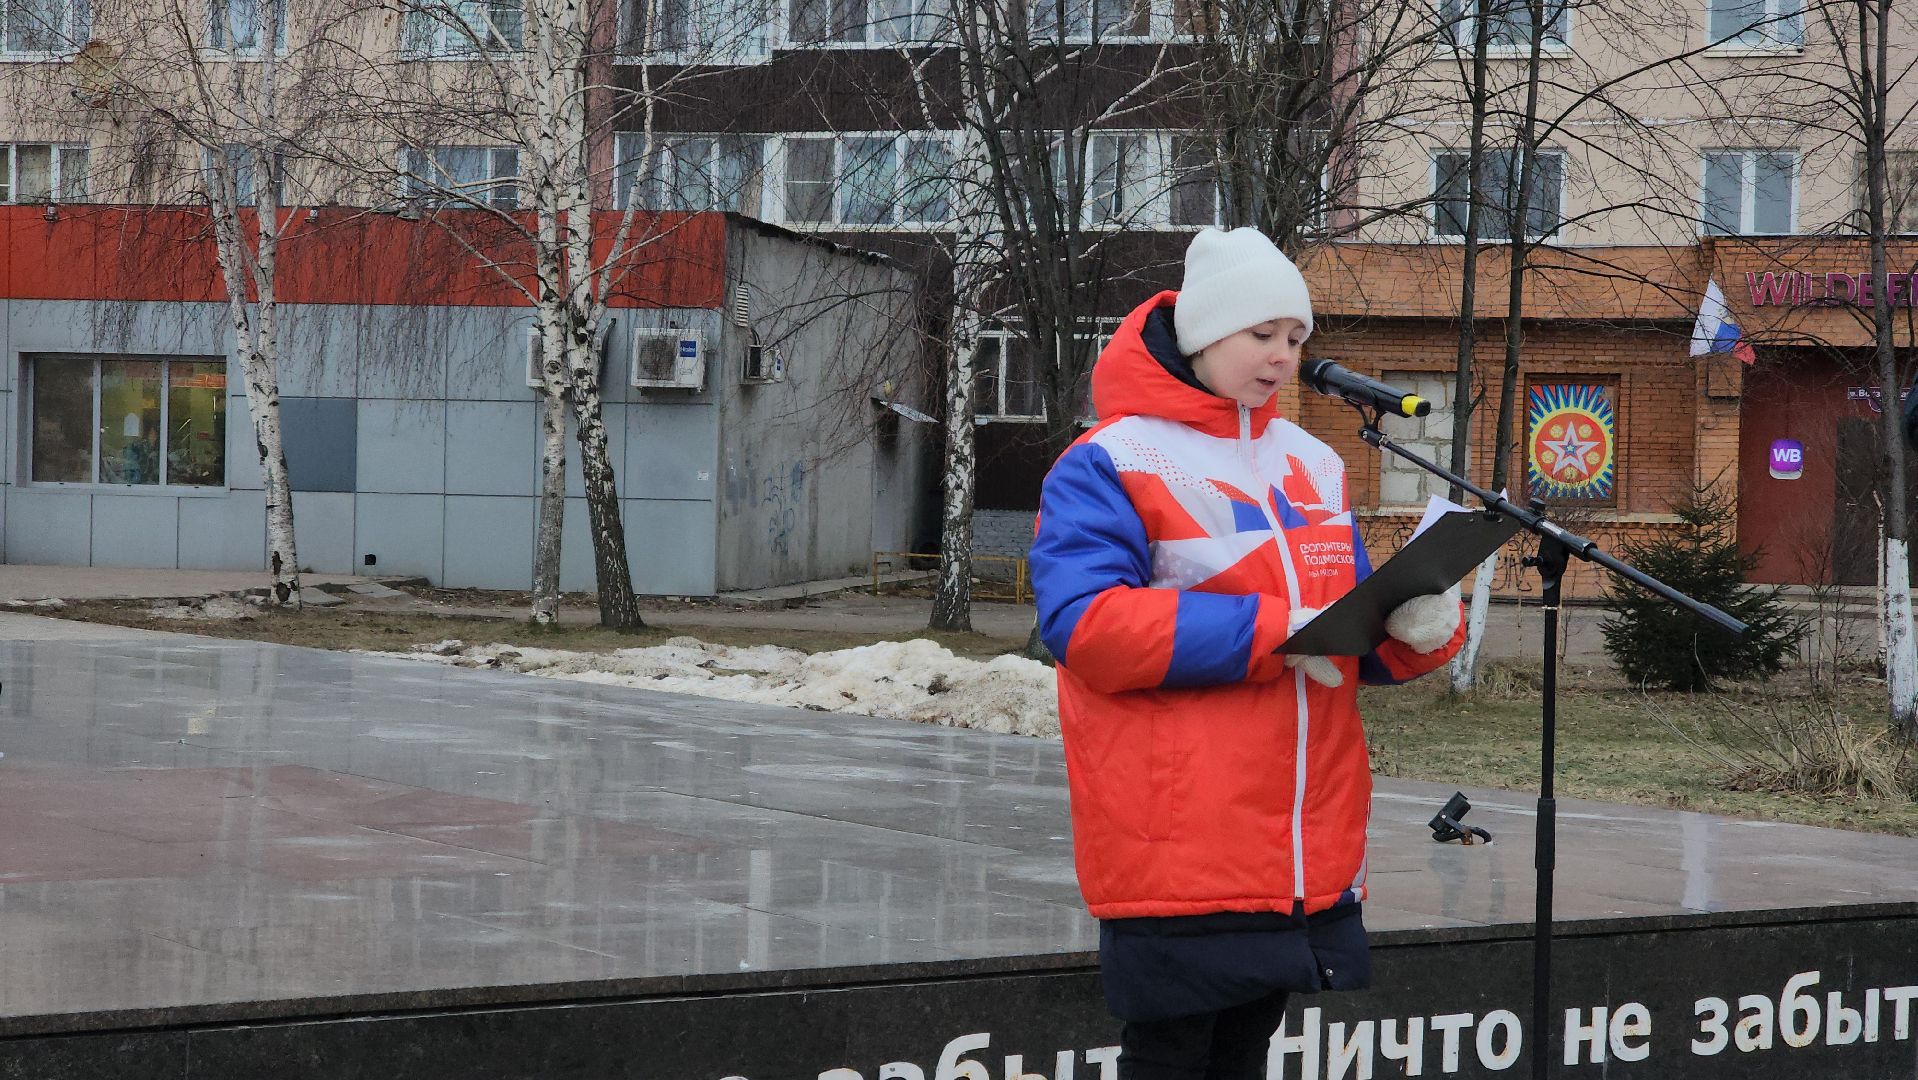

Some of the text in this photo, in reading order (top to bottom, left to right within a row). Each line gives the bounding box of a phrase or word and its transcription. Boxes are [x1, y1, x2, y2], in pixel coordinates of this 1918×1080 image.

[1746, 271, 1918, 307] WILDBE
[1773, 448, 1801, 463] WB
[1266, 1006, 1523, 1080] Ничто
[1563, 1001, 1651, 1066] не
[1691, 970, 1918, 1056] забыт
